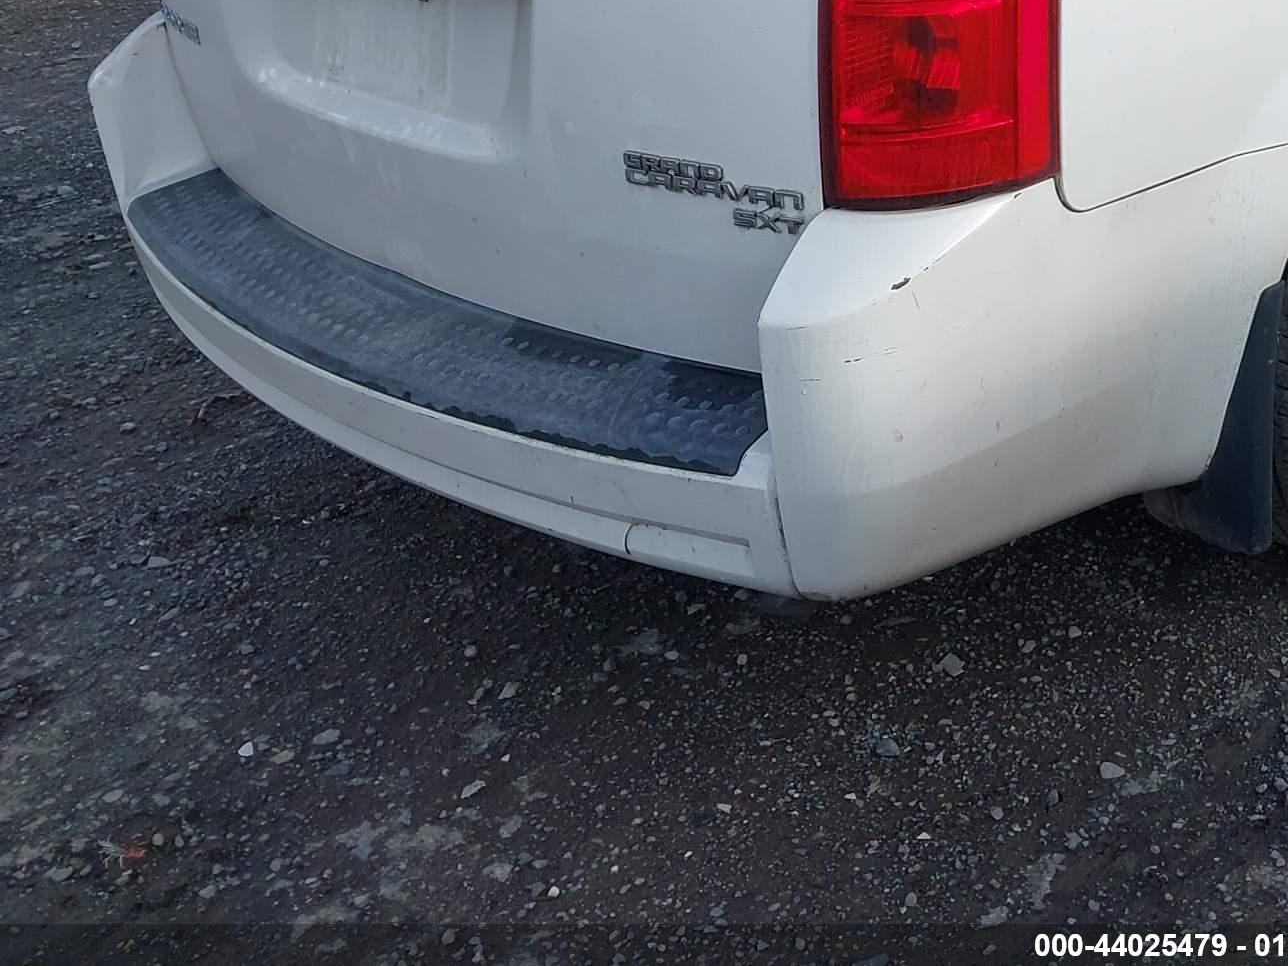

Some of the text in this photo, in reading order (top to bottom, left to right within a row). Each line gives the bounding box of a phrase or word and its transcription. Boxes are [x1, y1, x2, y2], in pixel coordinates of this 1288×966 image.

[622, 149, 724, 182] GRAND
[624, 167, 805, 211] CARAVAN
[732, 206, 805, 235] SXT
